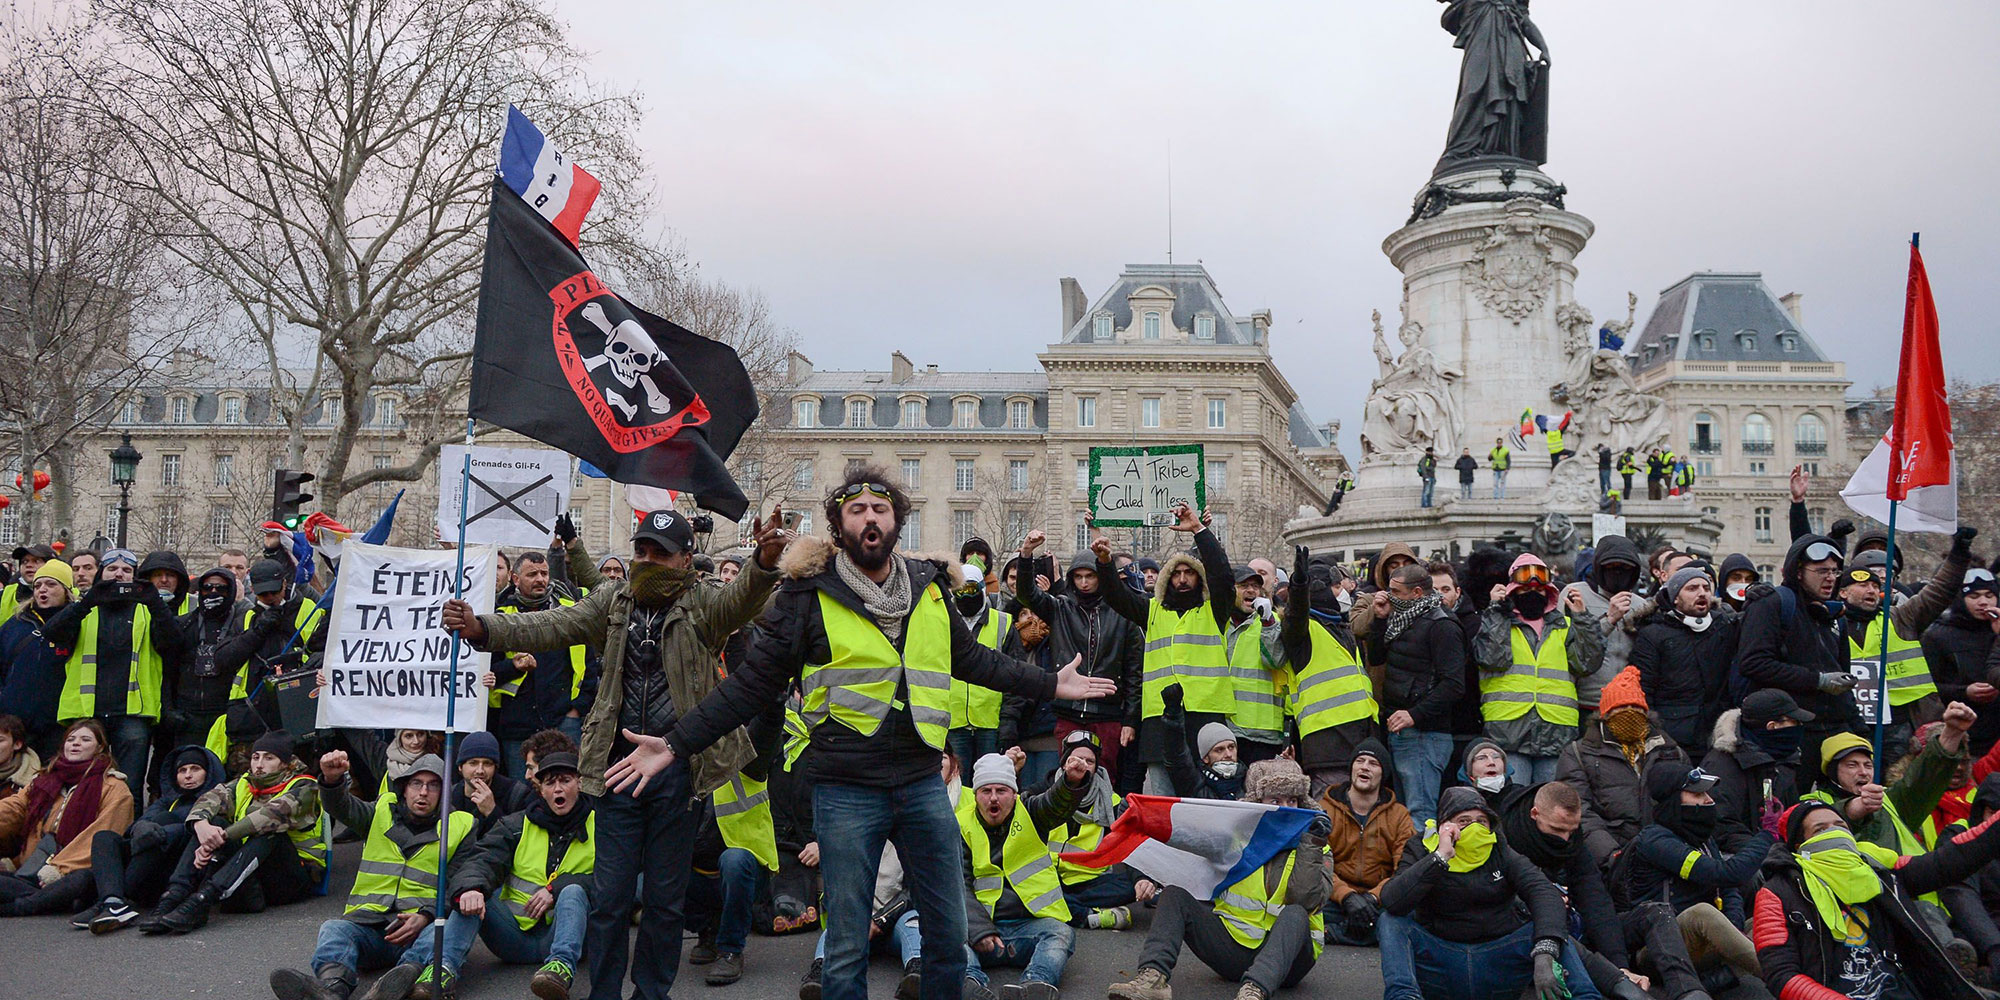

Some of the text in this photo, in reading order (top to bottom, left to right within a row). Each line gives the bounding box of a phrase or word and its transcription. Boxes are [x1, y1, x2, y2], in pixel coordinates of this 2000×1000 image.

[576, 376, 595, 402] NO
[471, 459, 512, 469] Grenades
[1123, 457, 1193, 481] A Tribe
[1100, 484, 1144, 511] Called
[355, 604, 394, 631] TA
[420, 636, 473, 662] NOS
[332, 668, 478, 698] RENCONTRER
